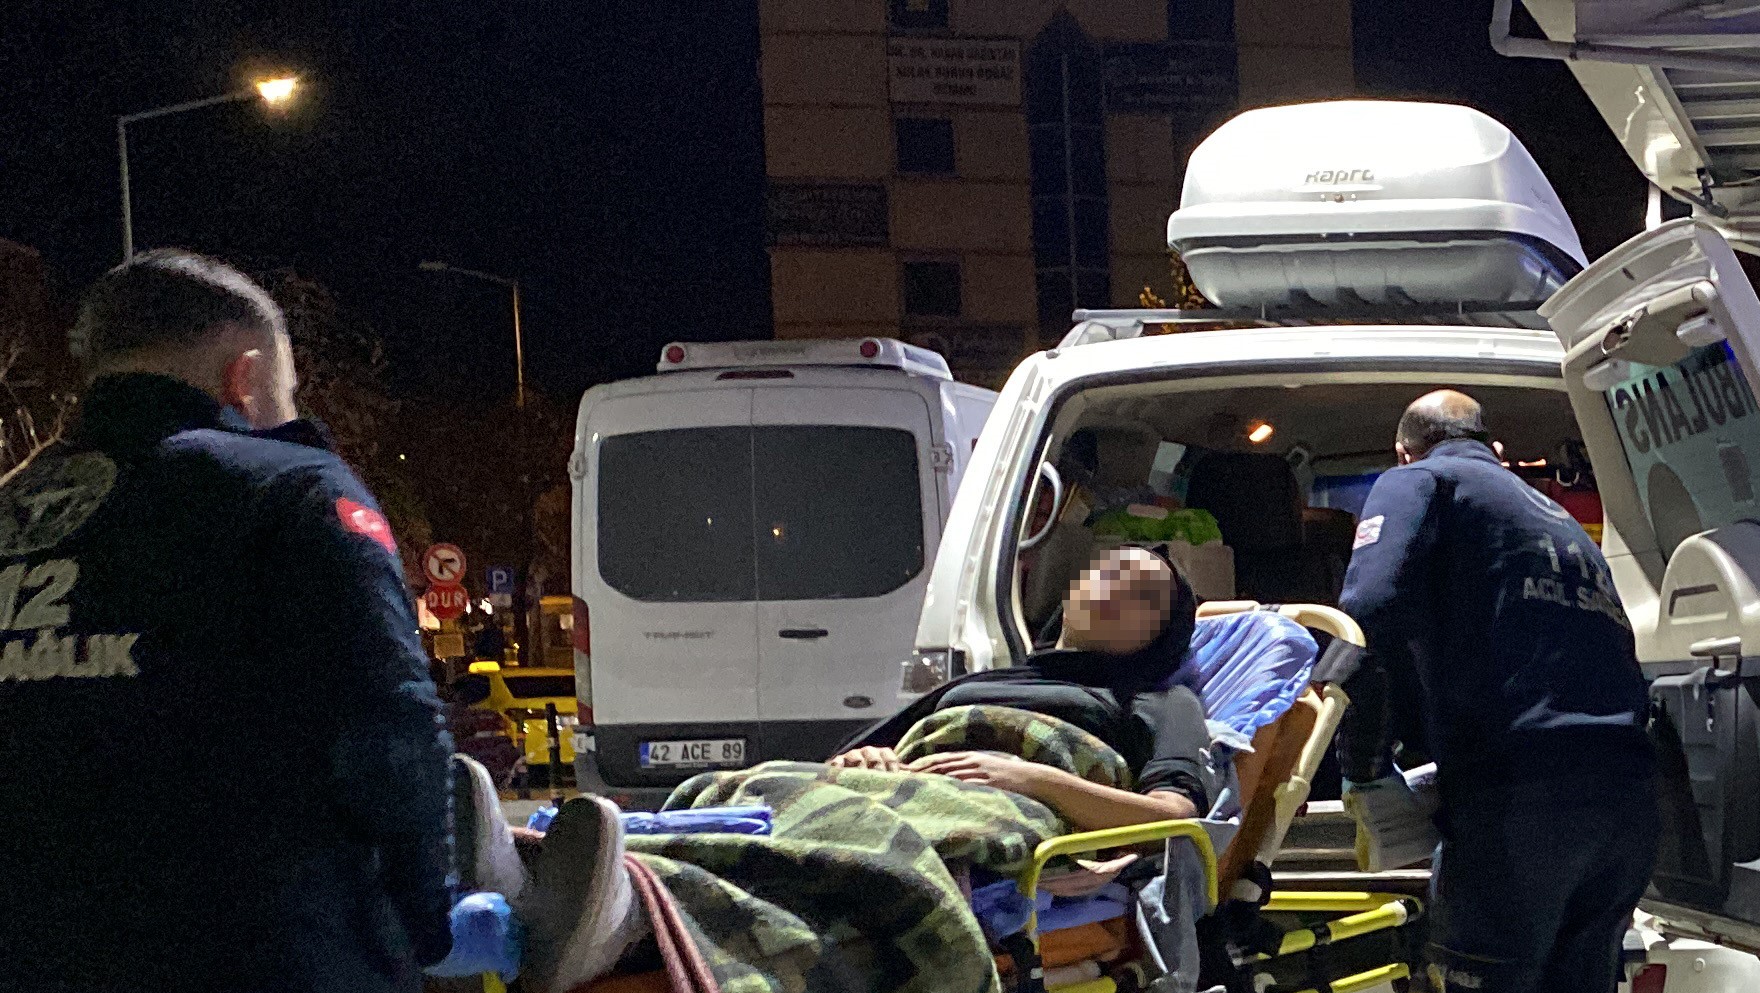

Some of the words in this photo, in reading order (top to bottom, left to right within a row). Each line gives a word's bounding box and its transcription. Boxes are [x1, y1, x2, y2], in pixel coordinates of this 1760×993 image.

[428, 591, 467, 608] DUR
[650, 744, 670, 761] 42
[681, 743, 711, 760] ACE
[722, 742, 742, 760] 89
